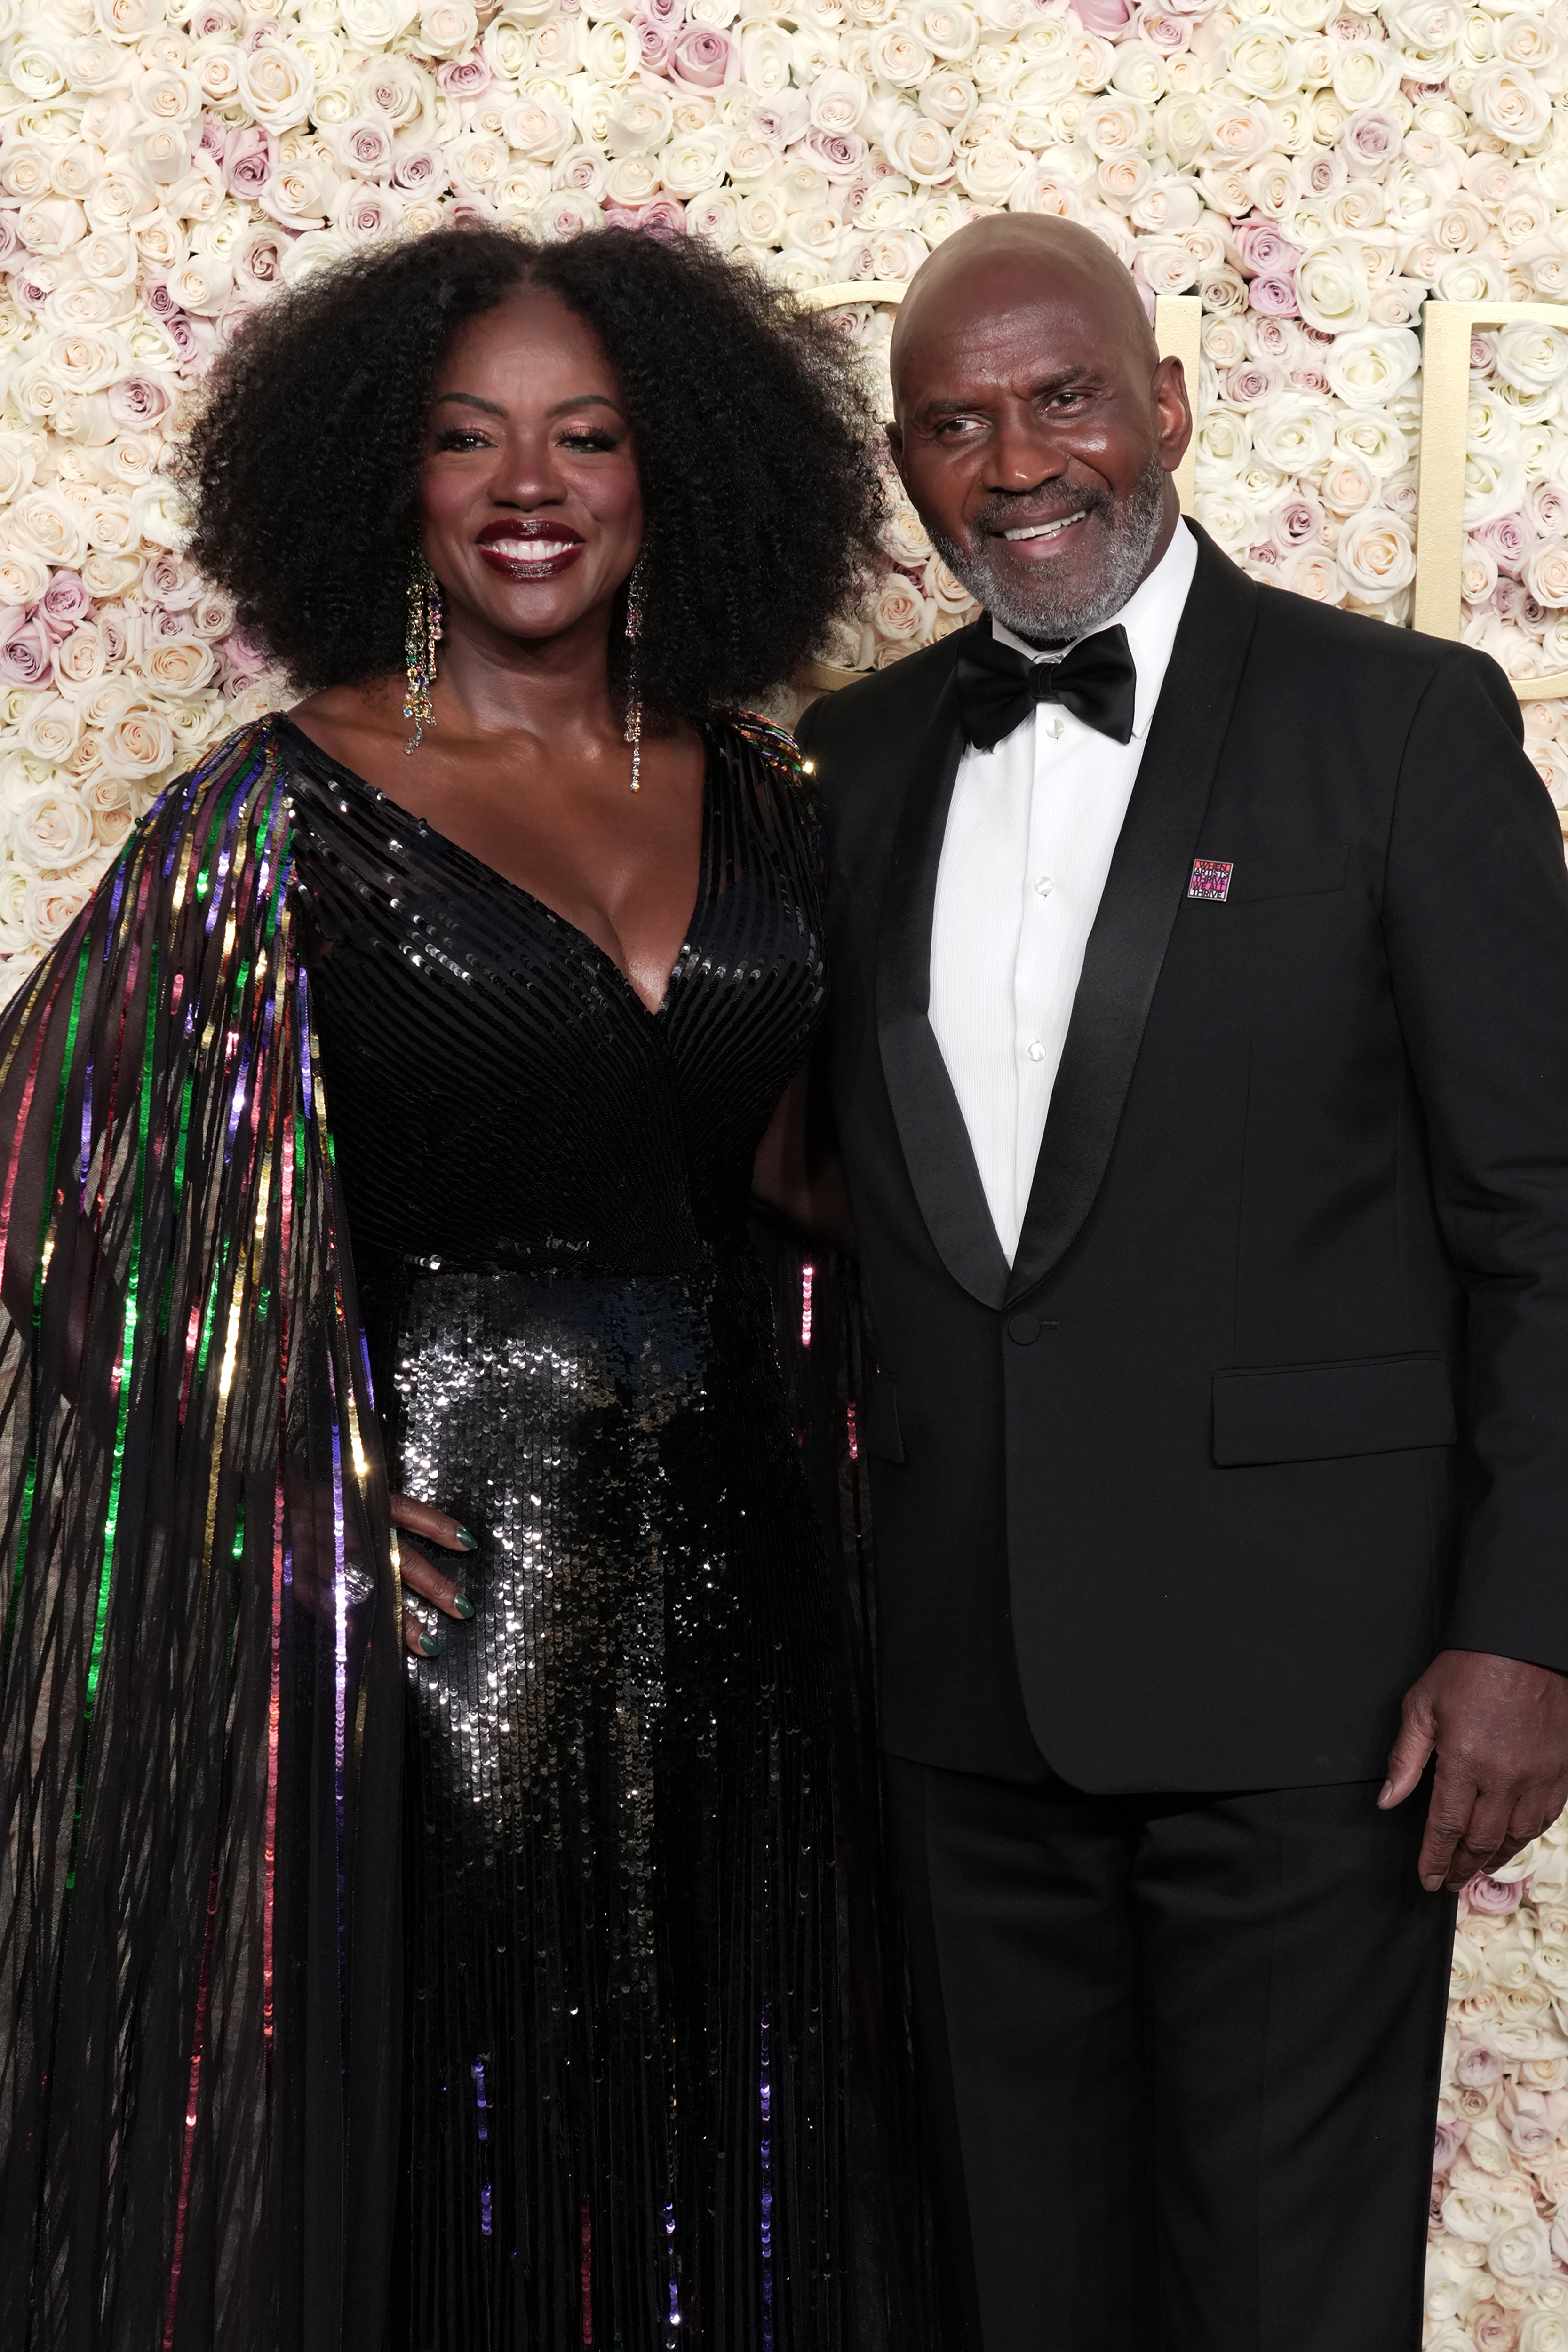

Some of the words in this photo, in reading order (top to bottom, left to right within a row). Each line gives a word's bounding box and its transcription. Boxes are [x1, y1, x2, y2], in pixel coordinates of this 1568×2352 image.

[1200, 861, 1226, 871] WHEN
[1194, 868, 1229, 878] ARTISTS
[1195, 875, 1225, 885] THRIVE
[1193, 881, 1206, 890] WE
[1193, 888, 1222, 898] THRIVE
